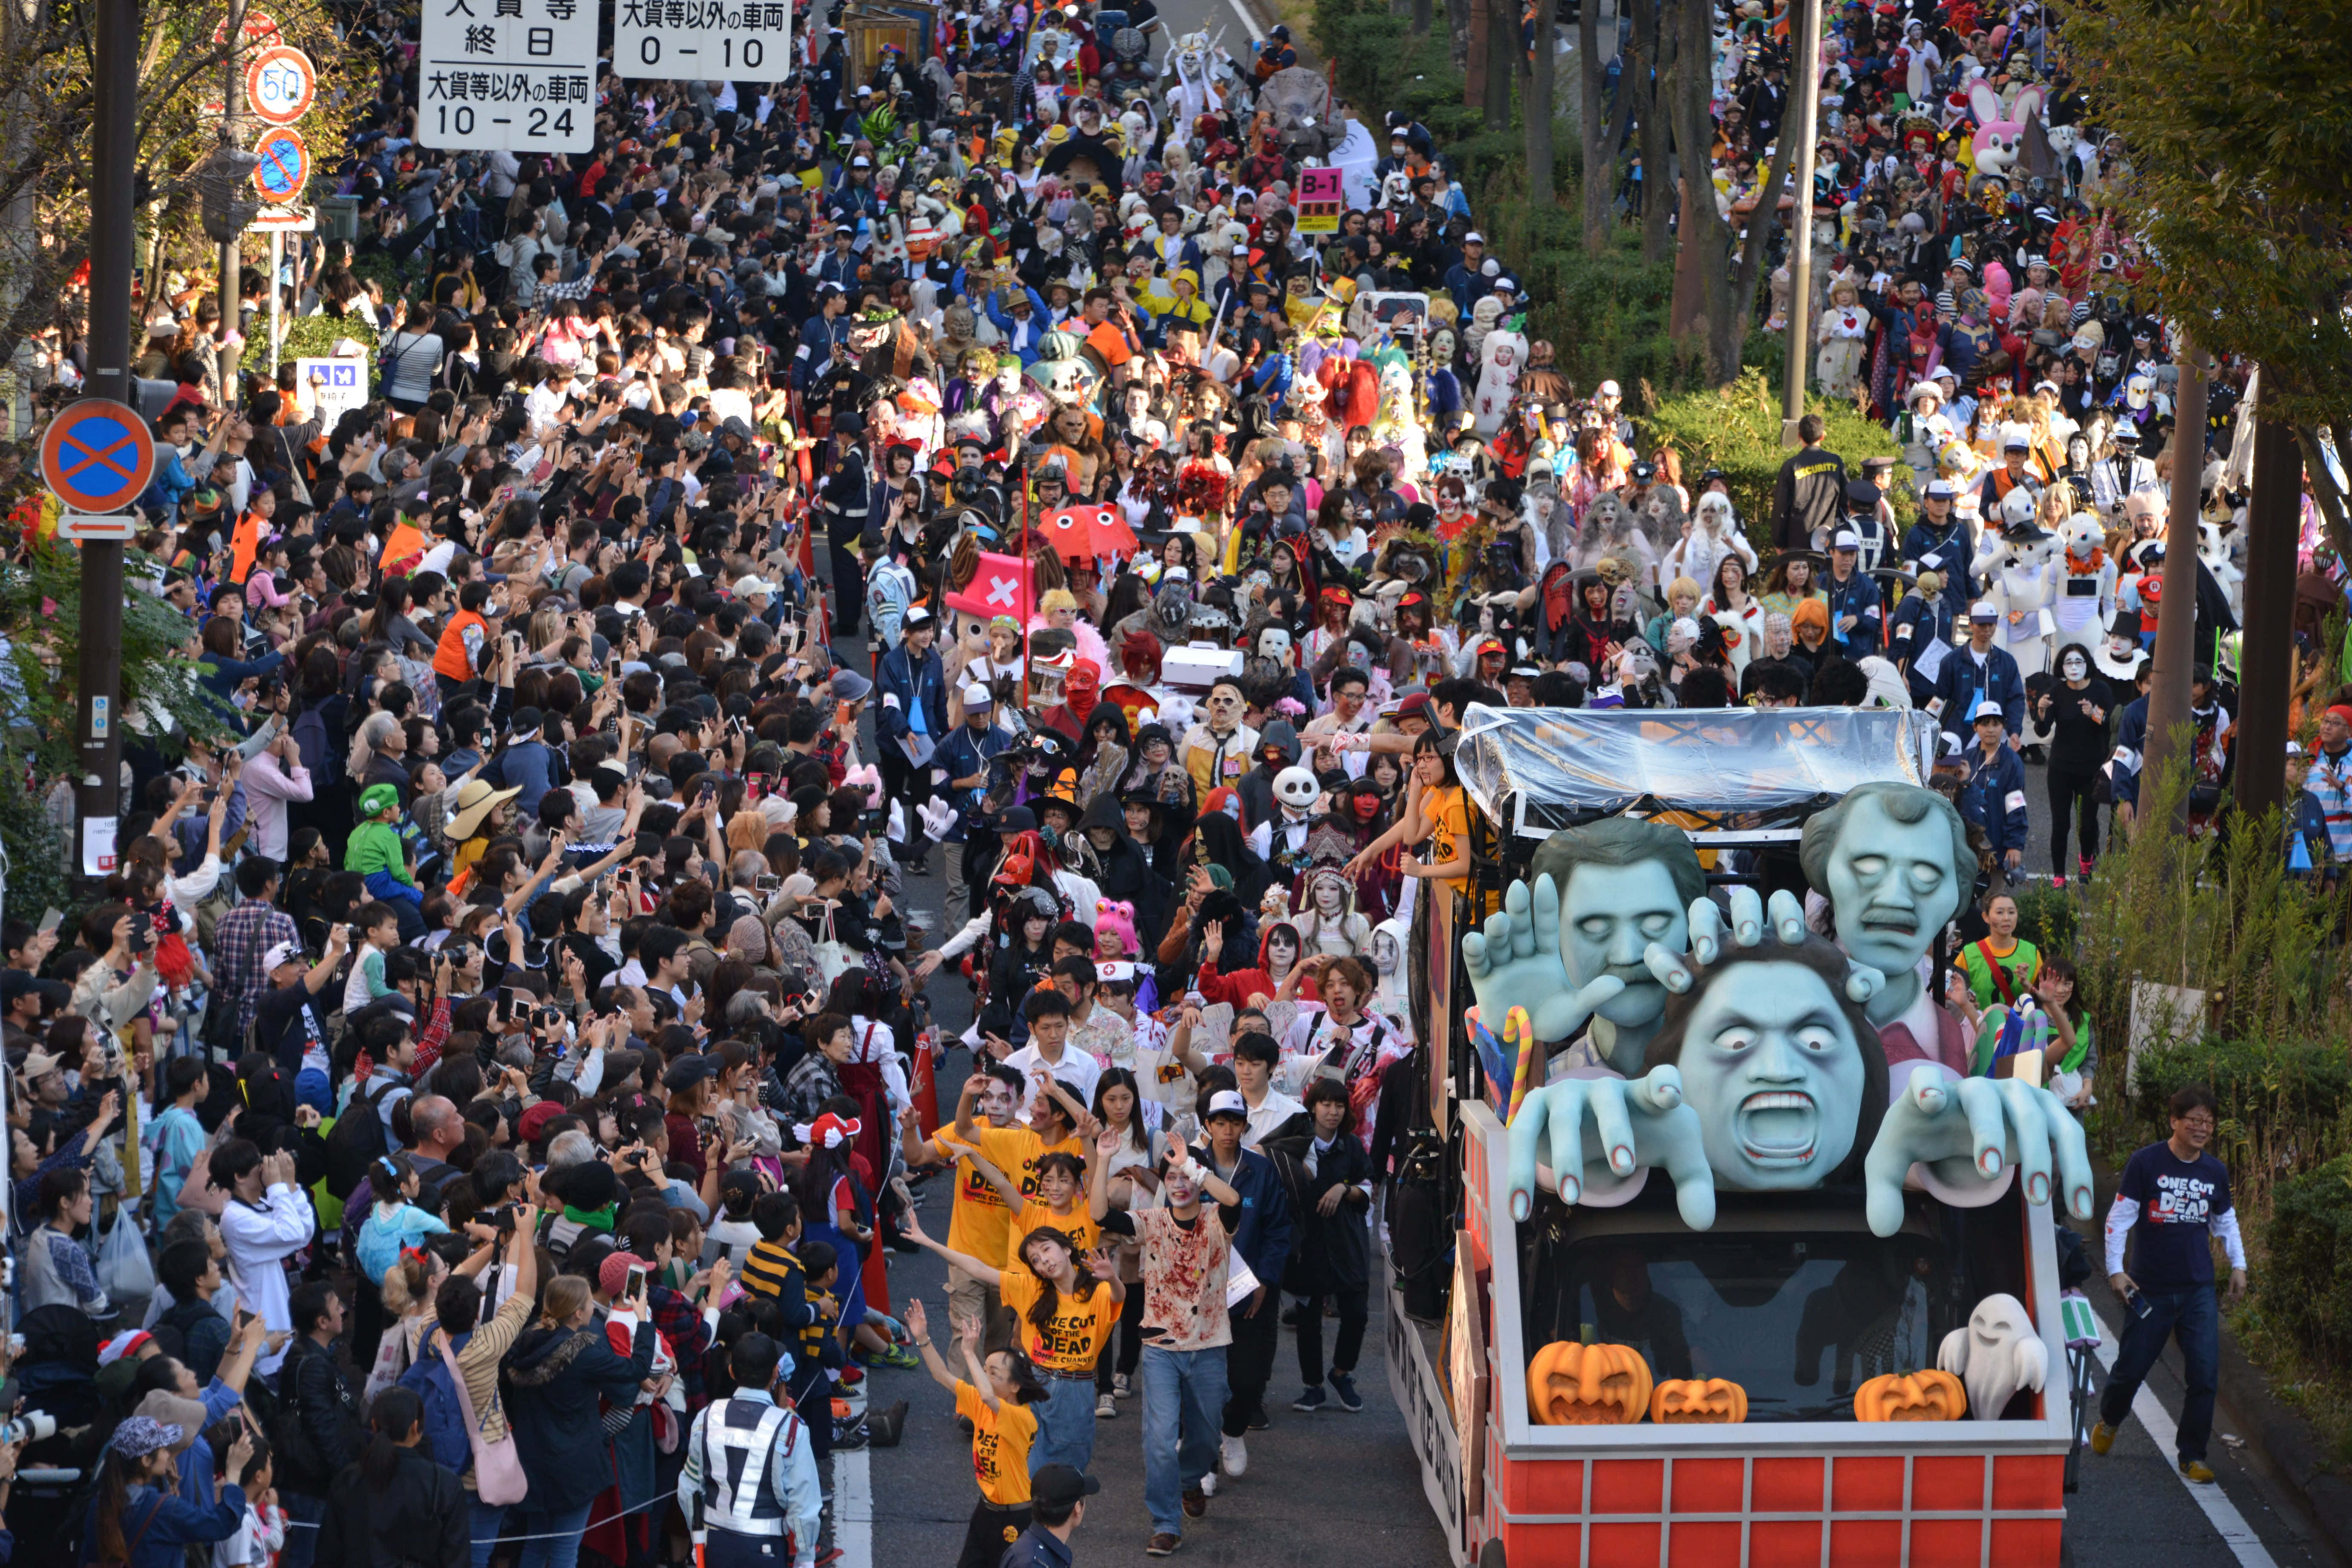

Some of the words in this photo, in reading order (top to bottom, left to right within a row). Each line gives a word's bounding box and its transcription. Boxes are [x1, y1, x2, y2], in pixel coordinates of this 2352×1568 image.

[623, 0, 784, 32] 大貨等以外の車両
[464, 24, 553, 56] 終日
[264, 69, 299, 101] 50
[427, 70, 589, 104] 大貨等以外の車両
[1302, 175, 1338, 193] B-1
[1794, 462, 1838, 480] SECURITY
[2157, 1174, 2189, 1190] ONE
[2188, 1178, 2215, 1195] CUT
[2173, 1189, 2185, 1197] OF
[2185, 1190, 2201, 1200] THE
[2159, 1191, 2209, 1217] DEAD
[1051, 1327, 1063, 1336] OF
[1069, 1314, 1096, 1329] CUT
[1041, 1332, 1091, 1355] DEAD
